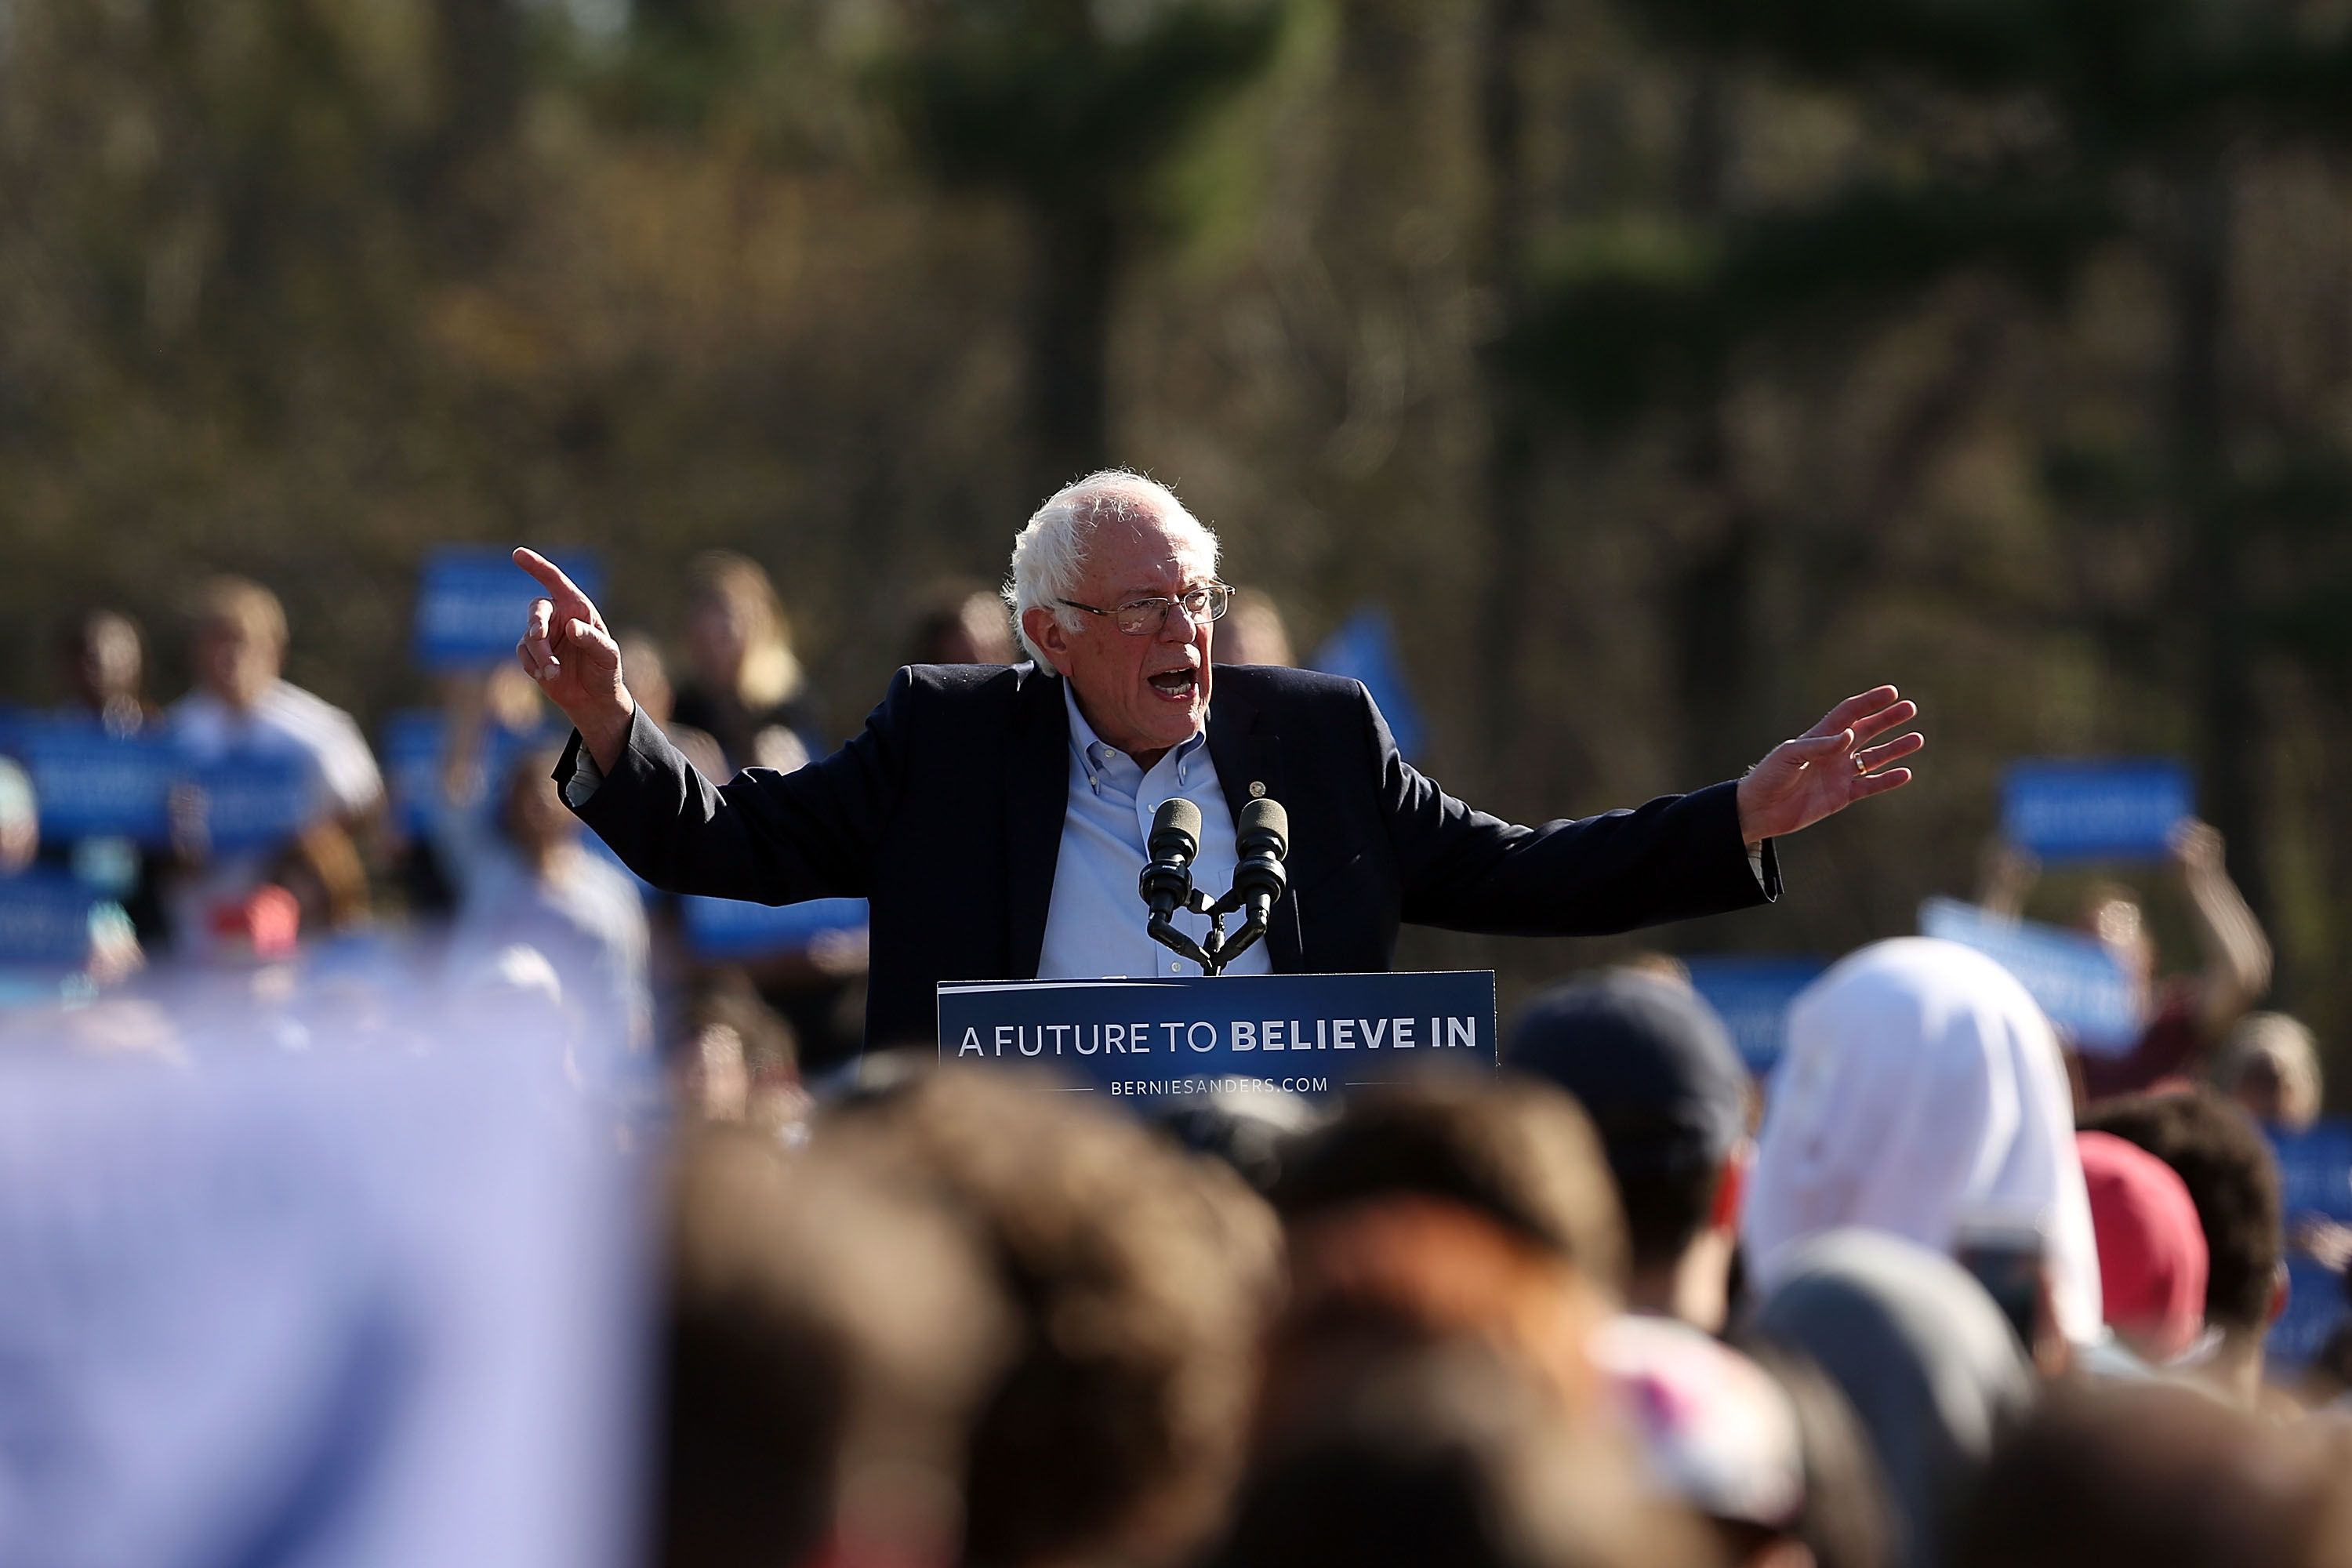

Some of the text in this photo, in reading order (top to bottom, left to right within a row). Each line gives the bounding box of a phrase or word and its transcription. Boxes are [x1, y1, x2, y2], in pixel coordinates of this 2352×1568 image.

[957, 1016, 1476, 1058] A FUTURE TO BELIEVE IN
[1110, 1077, 1328, 1096] BERNIESANDERS.COM
